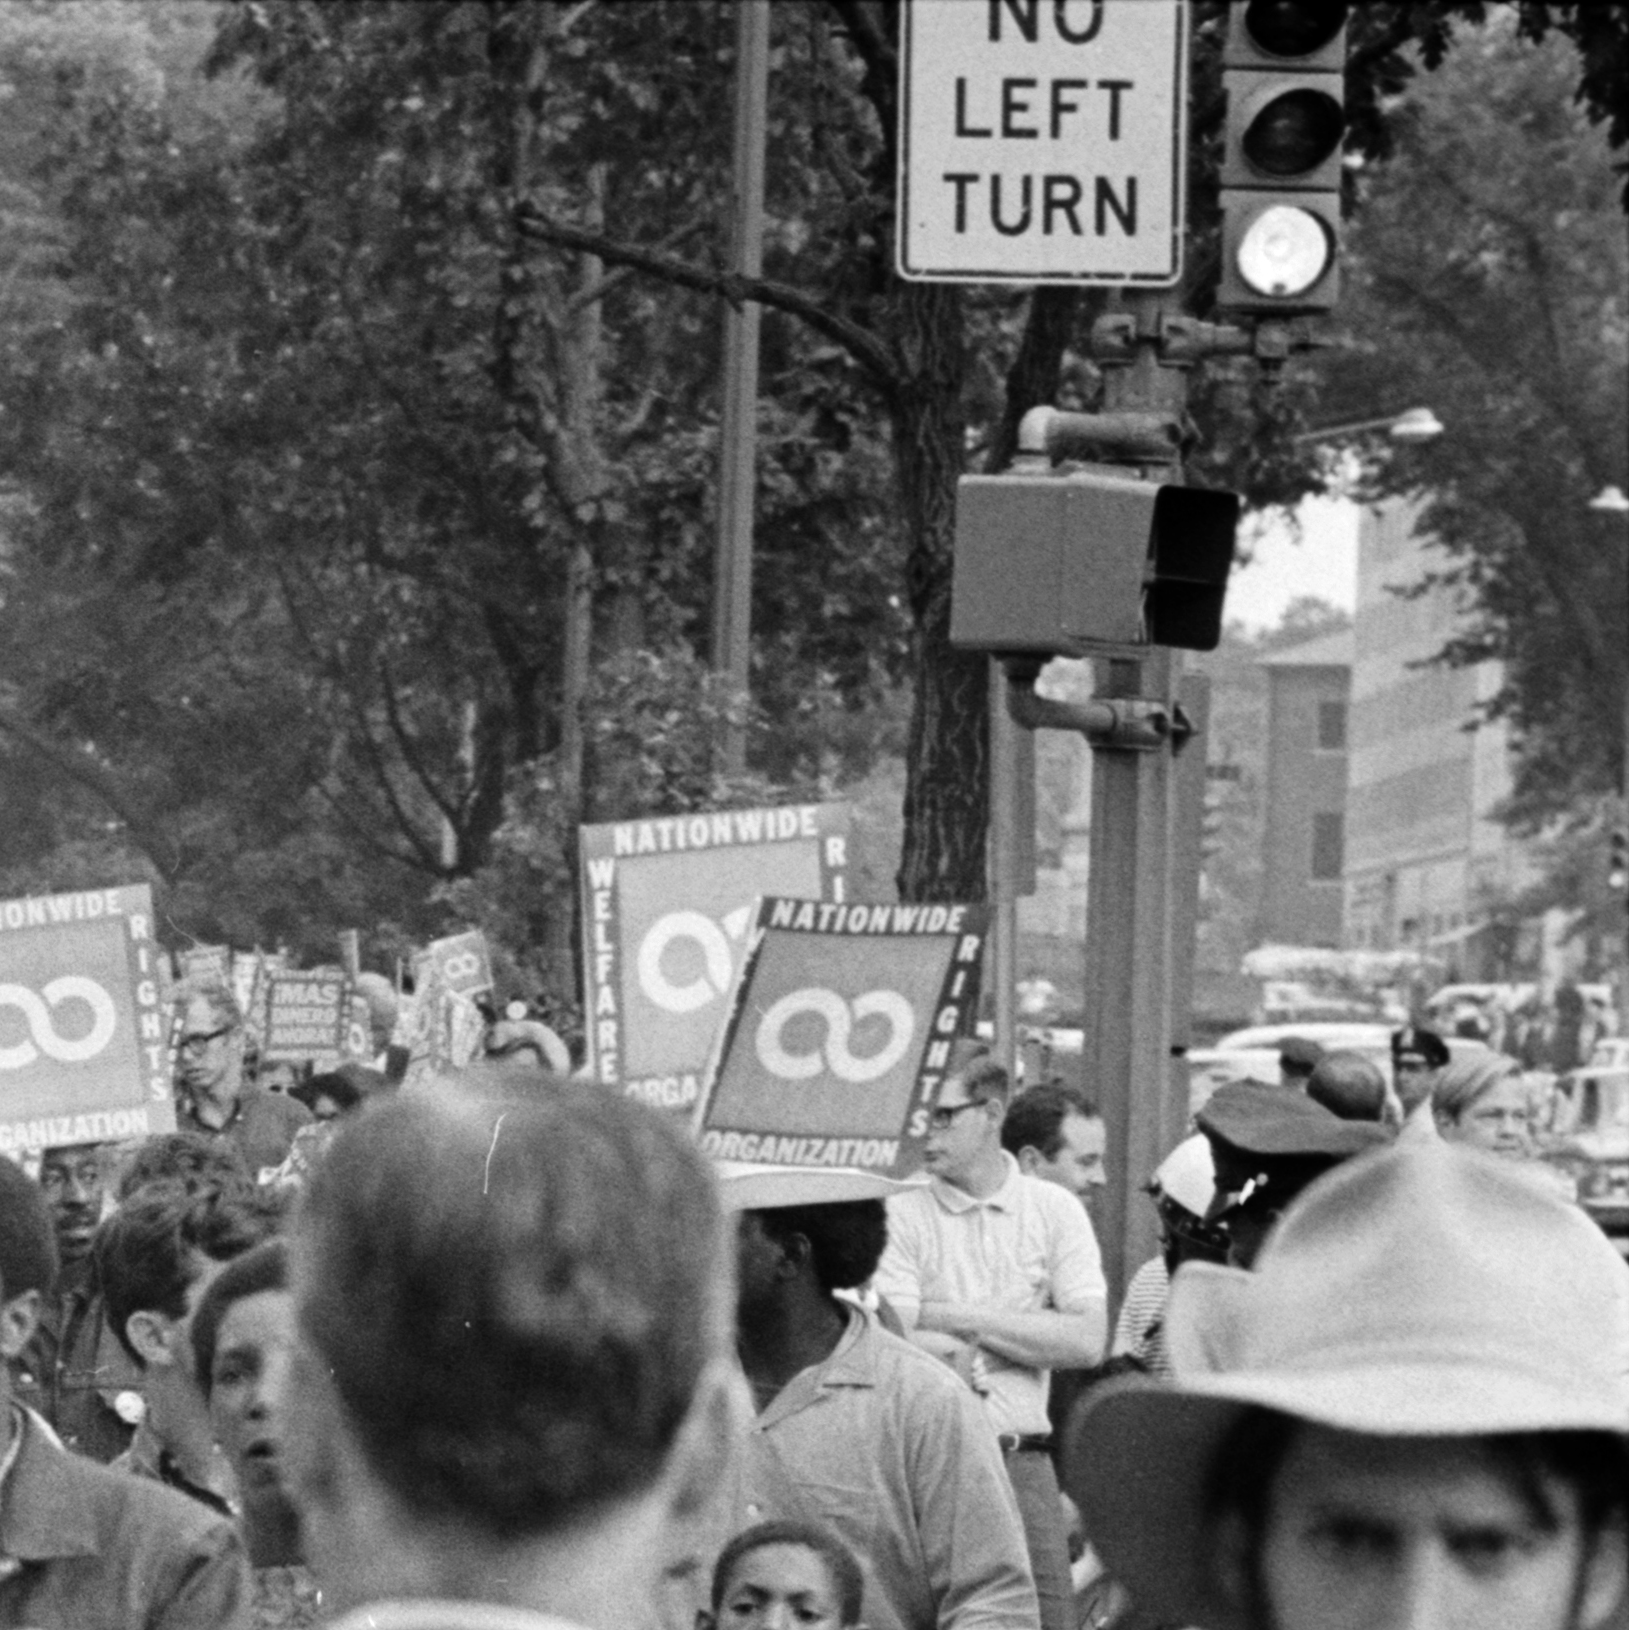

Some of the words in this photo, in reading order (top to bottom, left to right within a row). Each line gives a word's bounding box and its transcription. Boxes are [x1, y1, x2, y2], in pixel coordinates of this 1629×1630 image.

[989, 0, 1103, 44] NO
[955, 77, 1135, 140] LEFT
[943, 173, 1138, 237] TURN
[613, 806, 818, 856] NATIONWIDE
[771, 899, 967, 933] NATIONWIDE
[587, 857, 619, 1085] WELFARE
[129, 913, 168, 1102] RIGHTS
[908, 934, 980, 1138] RIGHTS
[702, 1129, 900, 1166] ORGANIZATION
